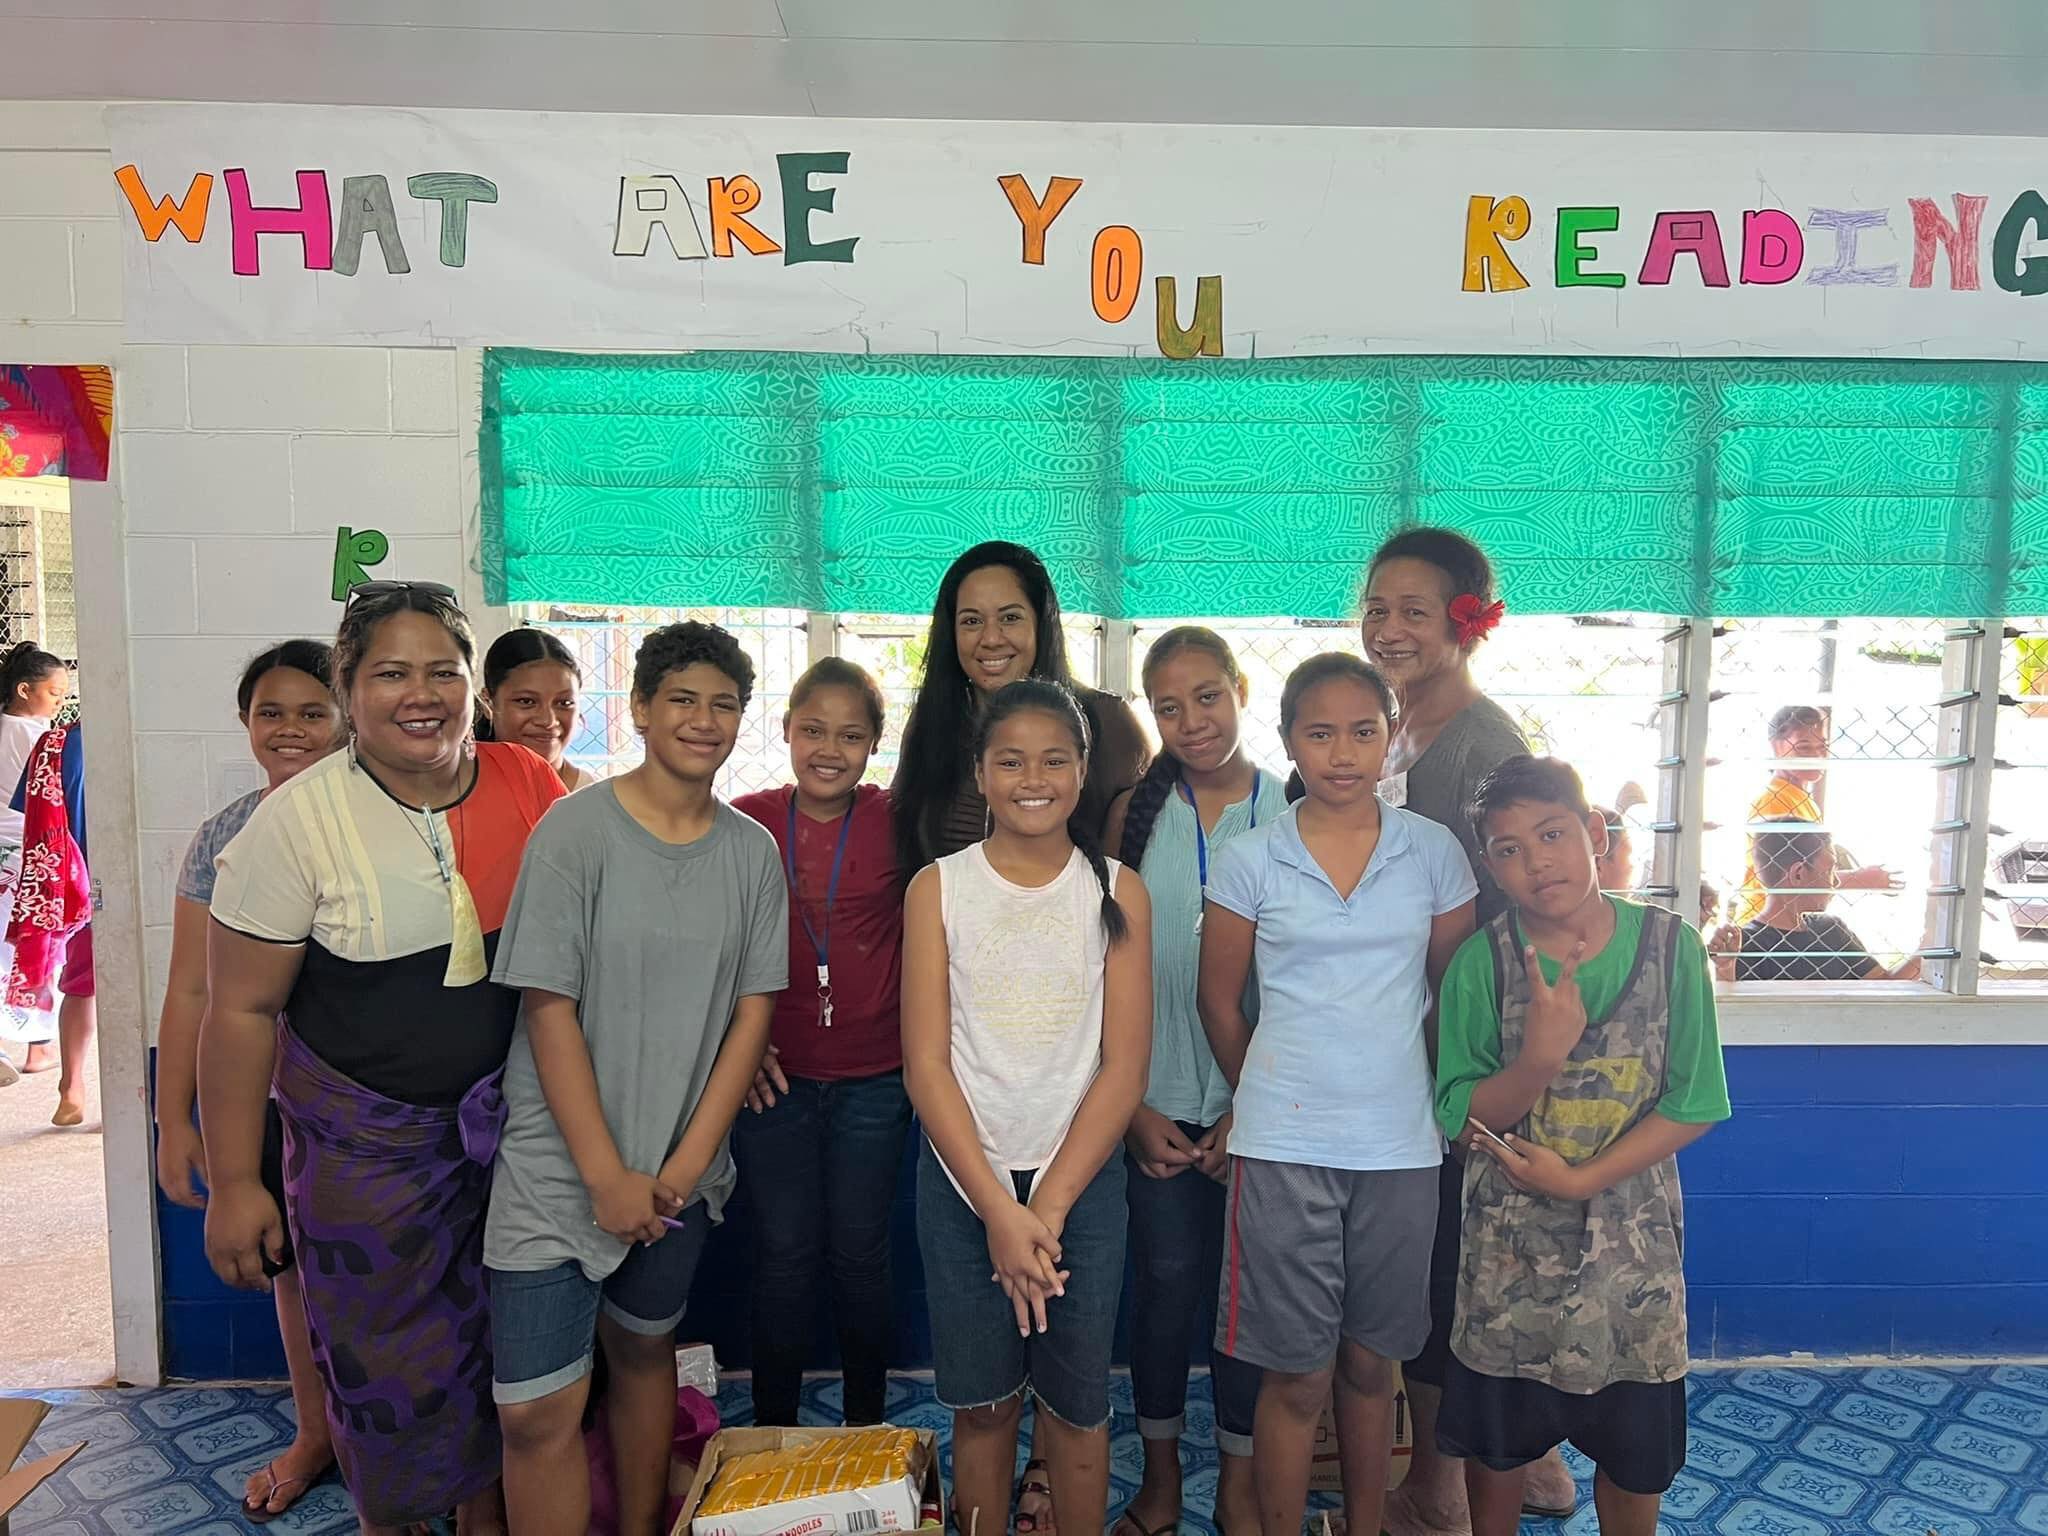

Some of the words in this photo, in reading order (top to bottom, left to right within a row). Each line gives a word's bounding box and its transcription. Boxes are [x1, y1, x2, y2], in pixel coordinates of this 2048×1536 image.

[114, 165, 498, 276] WHAT
[612, 152, 861, 266] ARE
[997, 174, 1224, 360] YOU
[1461, 189, 2048, 297] READING
[331, 526, 389, 602] R
